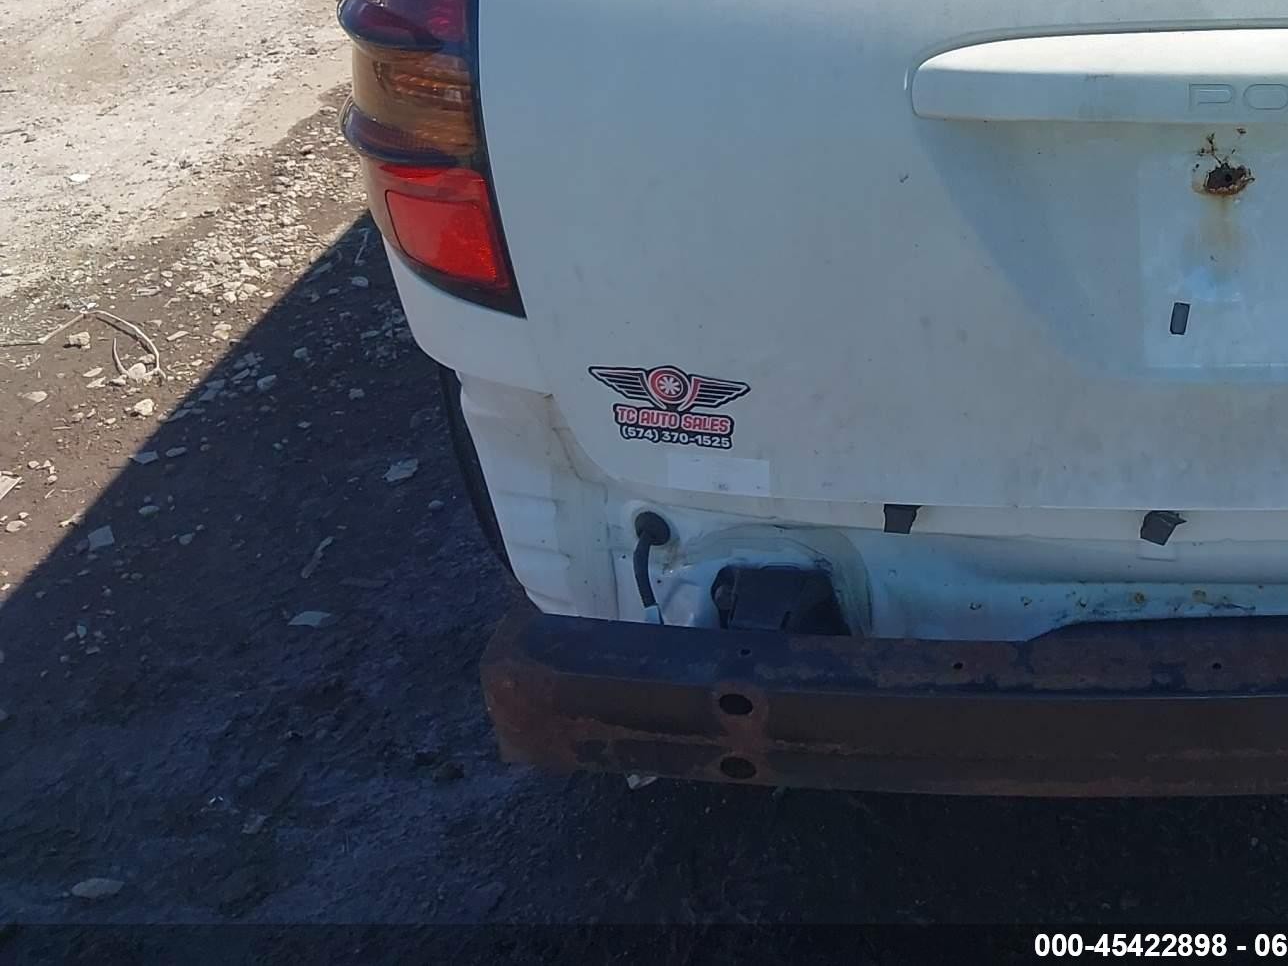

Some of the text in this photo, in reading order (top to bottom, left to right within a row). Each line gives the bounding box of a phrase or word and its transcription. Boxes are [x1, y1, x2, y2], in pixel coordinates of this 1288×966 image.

[617, 407, 729, 433] TC AUTO SALES
[622, 425, 730, 448] (574) 370-1525
